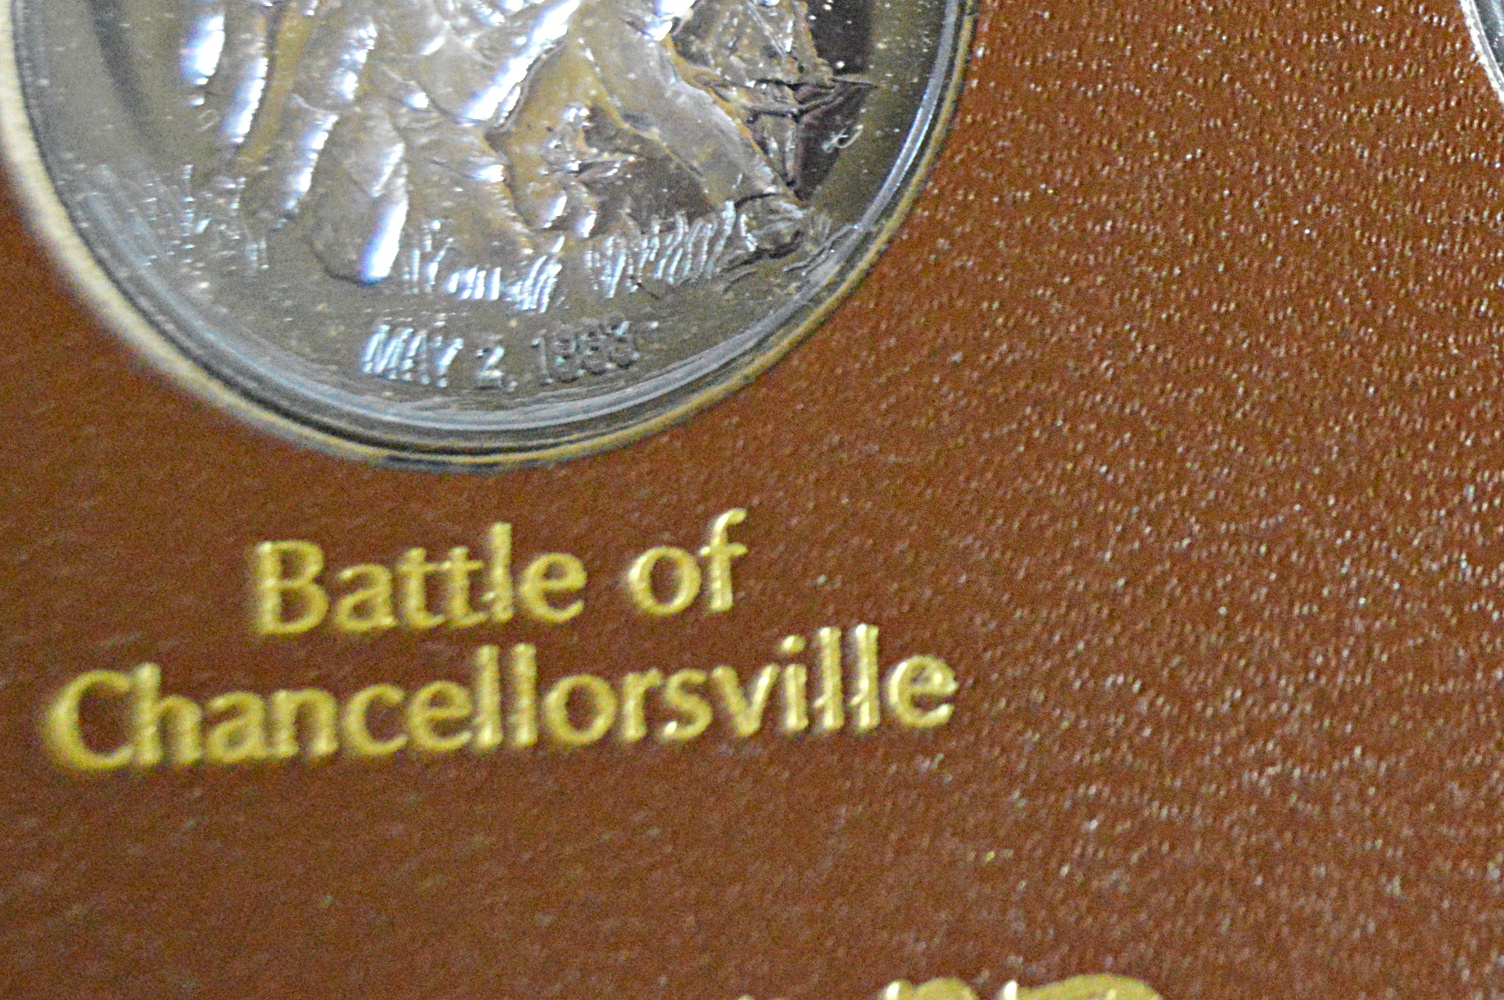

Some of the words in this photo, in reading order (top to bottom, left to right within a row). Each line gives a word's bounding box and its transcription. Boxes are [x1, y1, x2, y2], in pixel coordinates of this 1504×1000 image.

[361, 322, 464, 389] MAY
[252, 521, 587, 638] Battle
[626, 507, 750, 617] of
[45, 622, 960, 773] Chancellorsville
